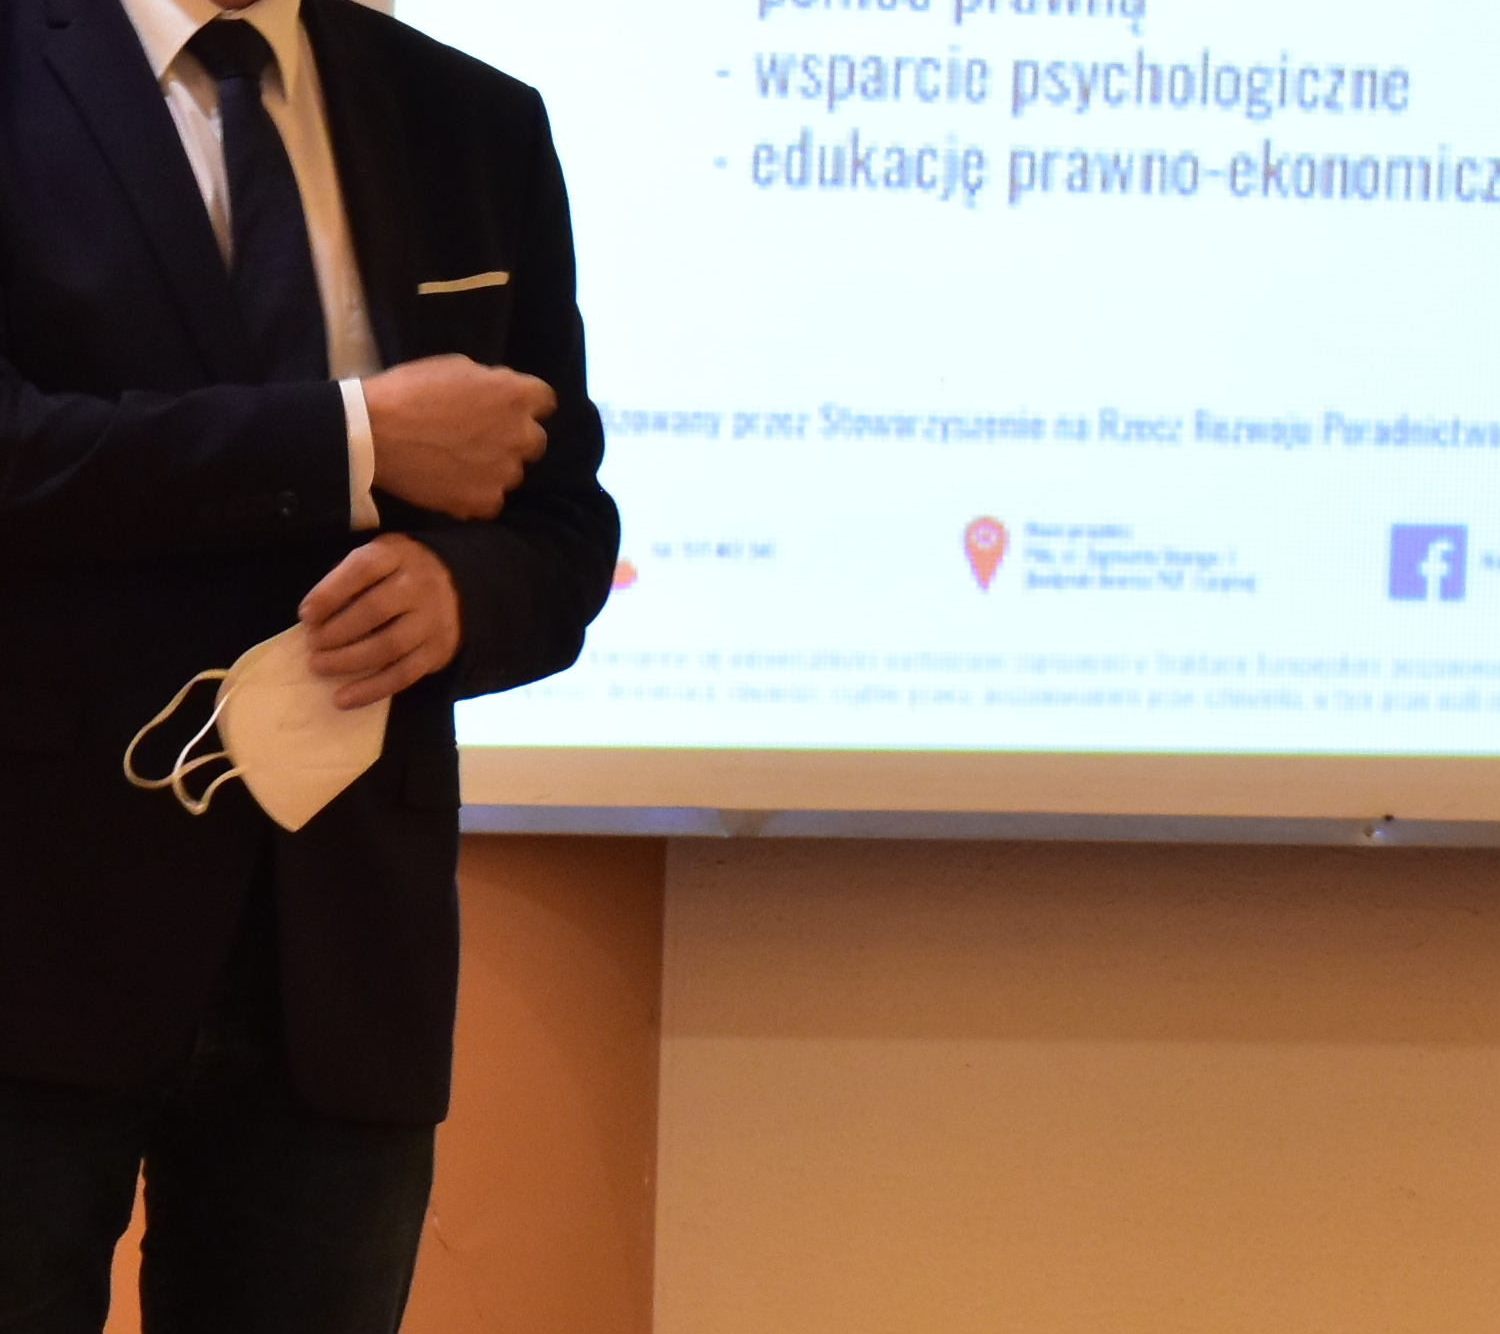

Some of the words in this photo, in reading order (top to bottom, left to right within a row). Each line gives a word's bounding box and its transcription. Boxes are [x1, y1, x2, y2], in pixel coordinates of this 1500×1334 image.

[754, 43, 991, 114] wsparcie
[1010, 45, 1411, 121] psychologiczne
[749, 125, 987, 210] edukację
